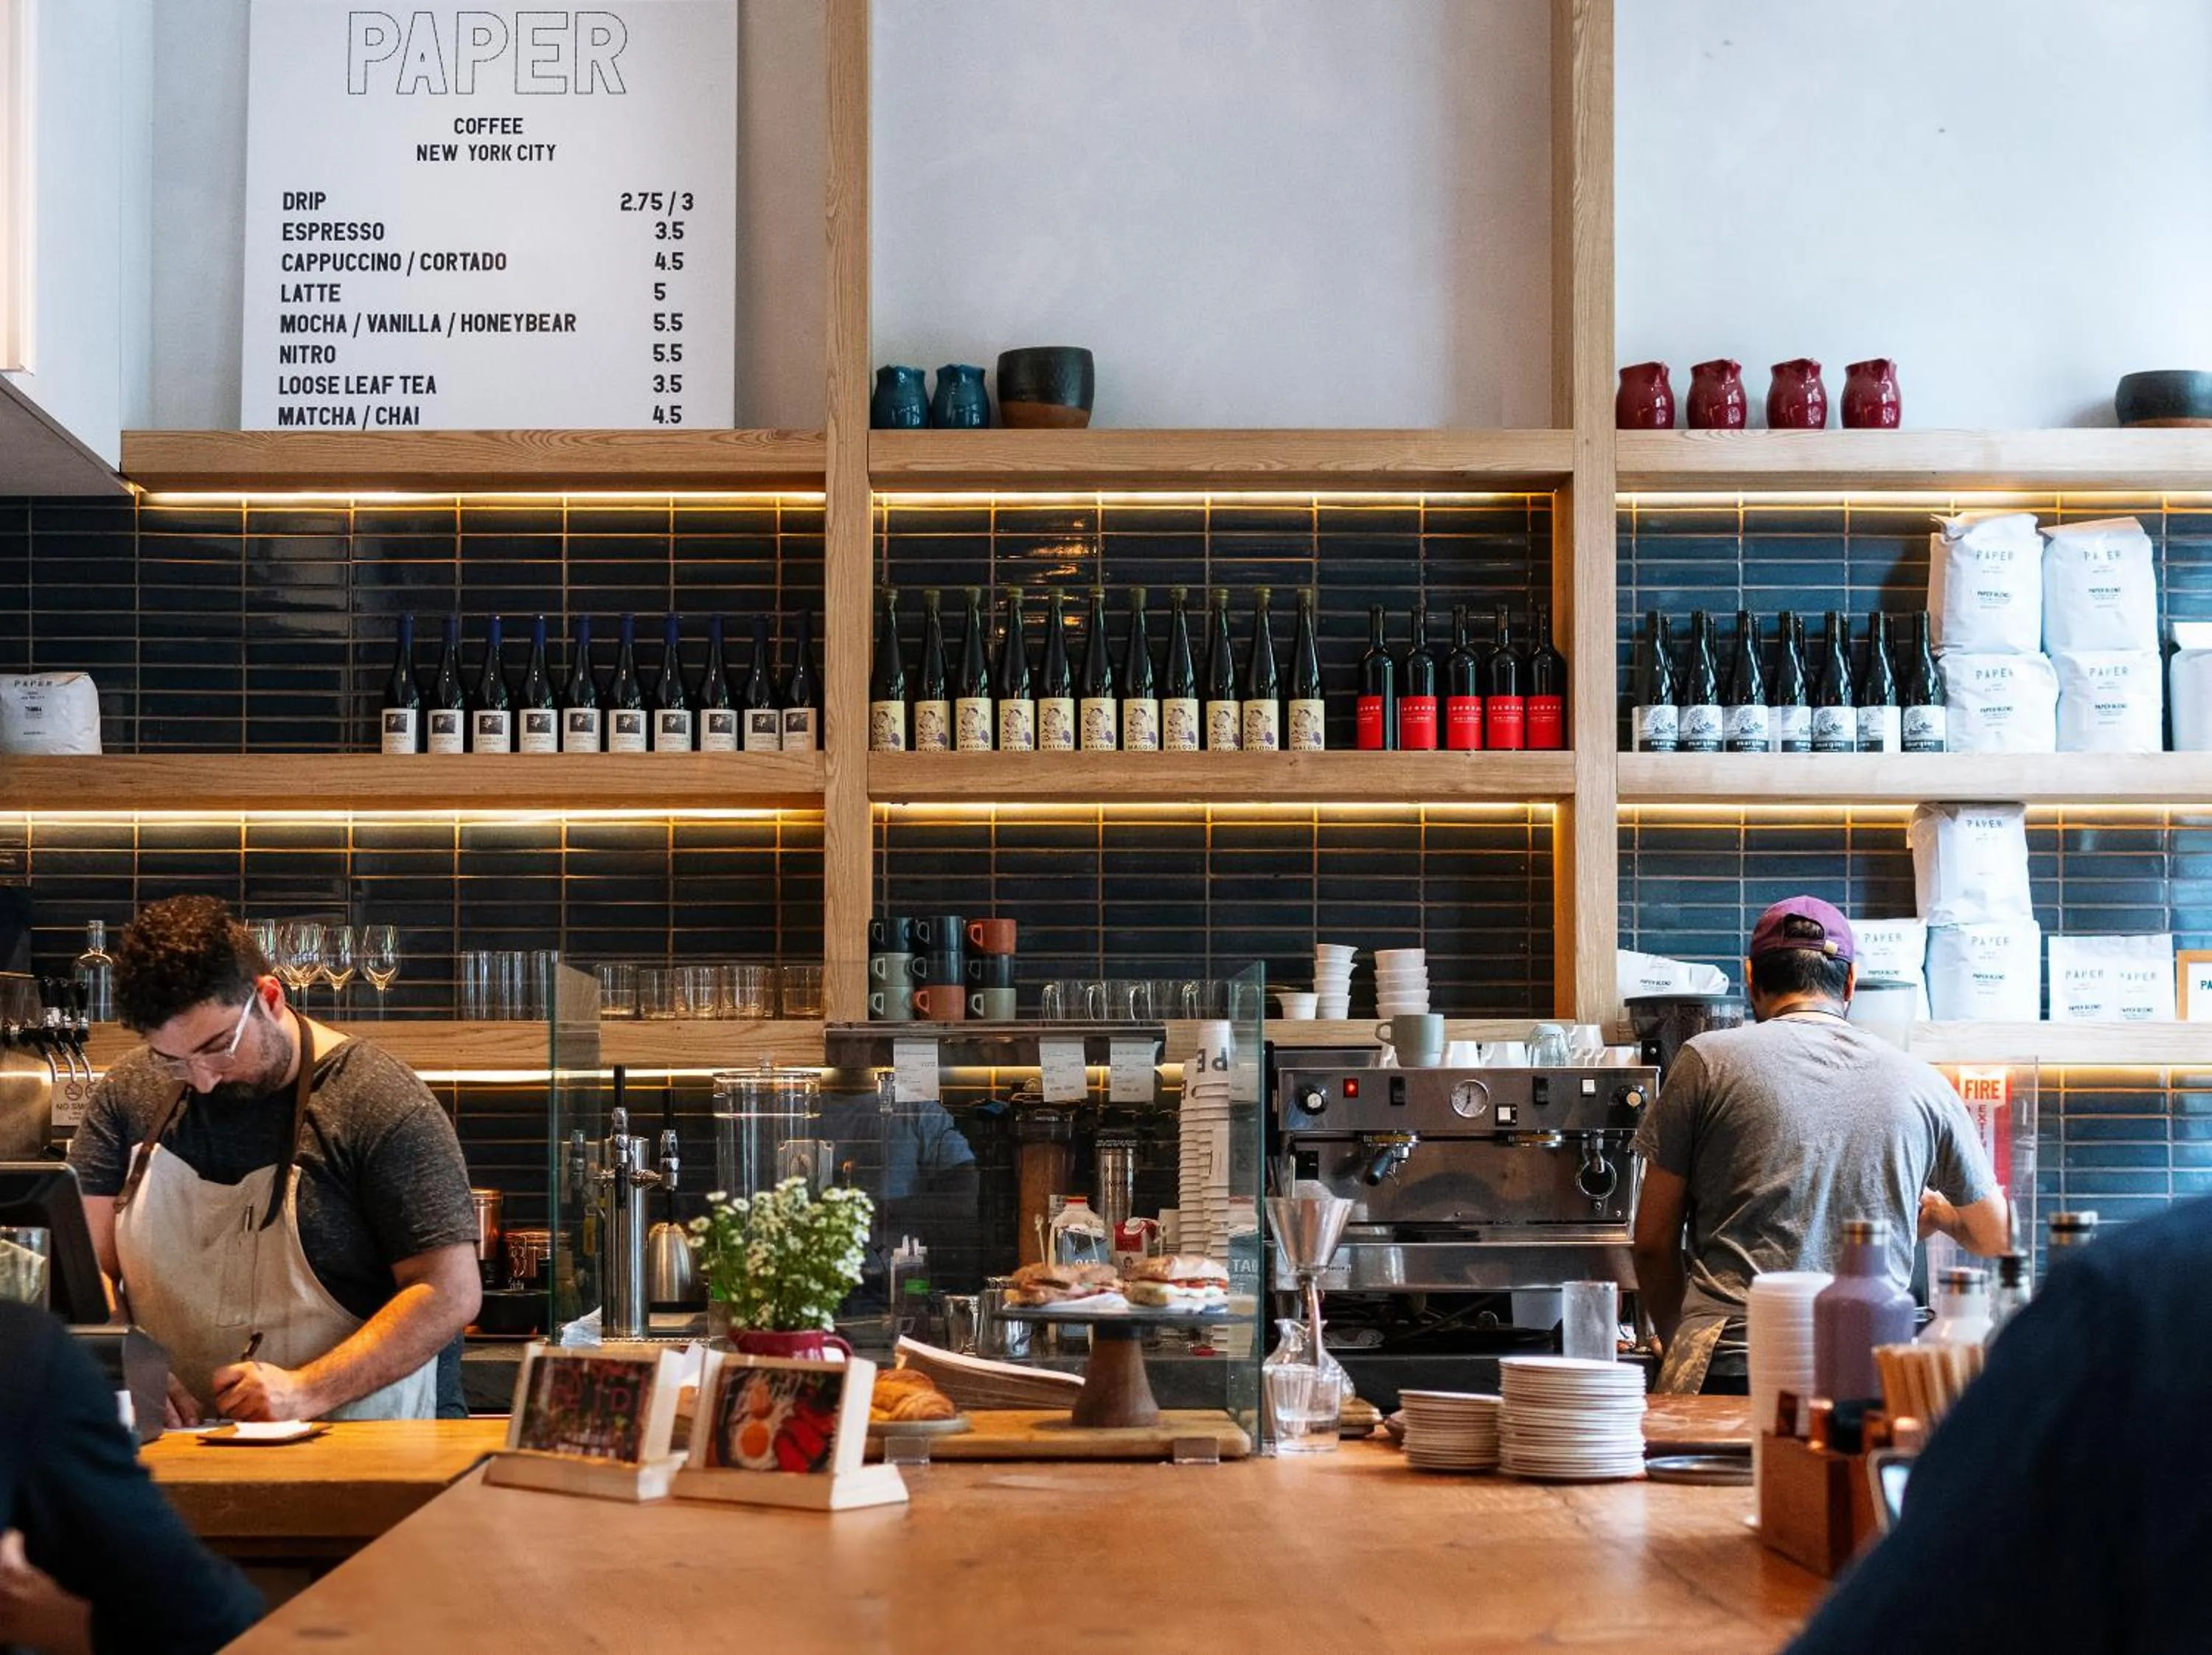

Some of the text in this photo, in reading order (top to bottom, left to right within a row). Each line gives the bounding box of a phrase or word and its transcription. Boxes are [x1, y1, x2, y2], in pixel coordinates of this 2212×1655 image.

[347, 11, 627, 94] PAPER
[453, 117, 524, 135] COFFEE
[417, 144, 556, 162] NEW YORK CITY
[282, 191, 327, 211] DRIP
[620, 191, 694, 217] 2.75 / 3
[282, 222, 384, 241] ESPRESSO
[655, 221, 685, 240] 3.5
[282, 251, 507, 277] CAPPUCCINO / CORTADO
[654, 251, 684, 271] 4.5
[281, 283, 341, 303] LATTE
[654, 282, 667, 302] 5
[280, 312, 577, 339] MOCHA / VANILLA / HONEYBEAR
[653, 313, 684, 332] 5.5
[279, 344, 336, 364] NITRO
[653, 343, 683, 363] 5.5
[279, 375, 437, 395] LOOSE LEAF TEA
[653, 374, 683, 393] 3.5
[278, 405, 420, 429] MATCHA / CHAI
[653, 405, 682, 424] 4.5
[2084, 550, 2122, 561] PAER
[1964, 1079, 2000, 1100] FIRE
